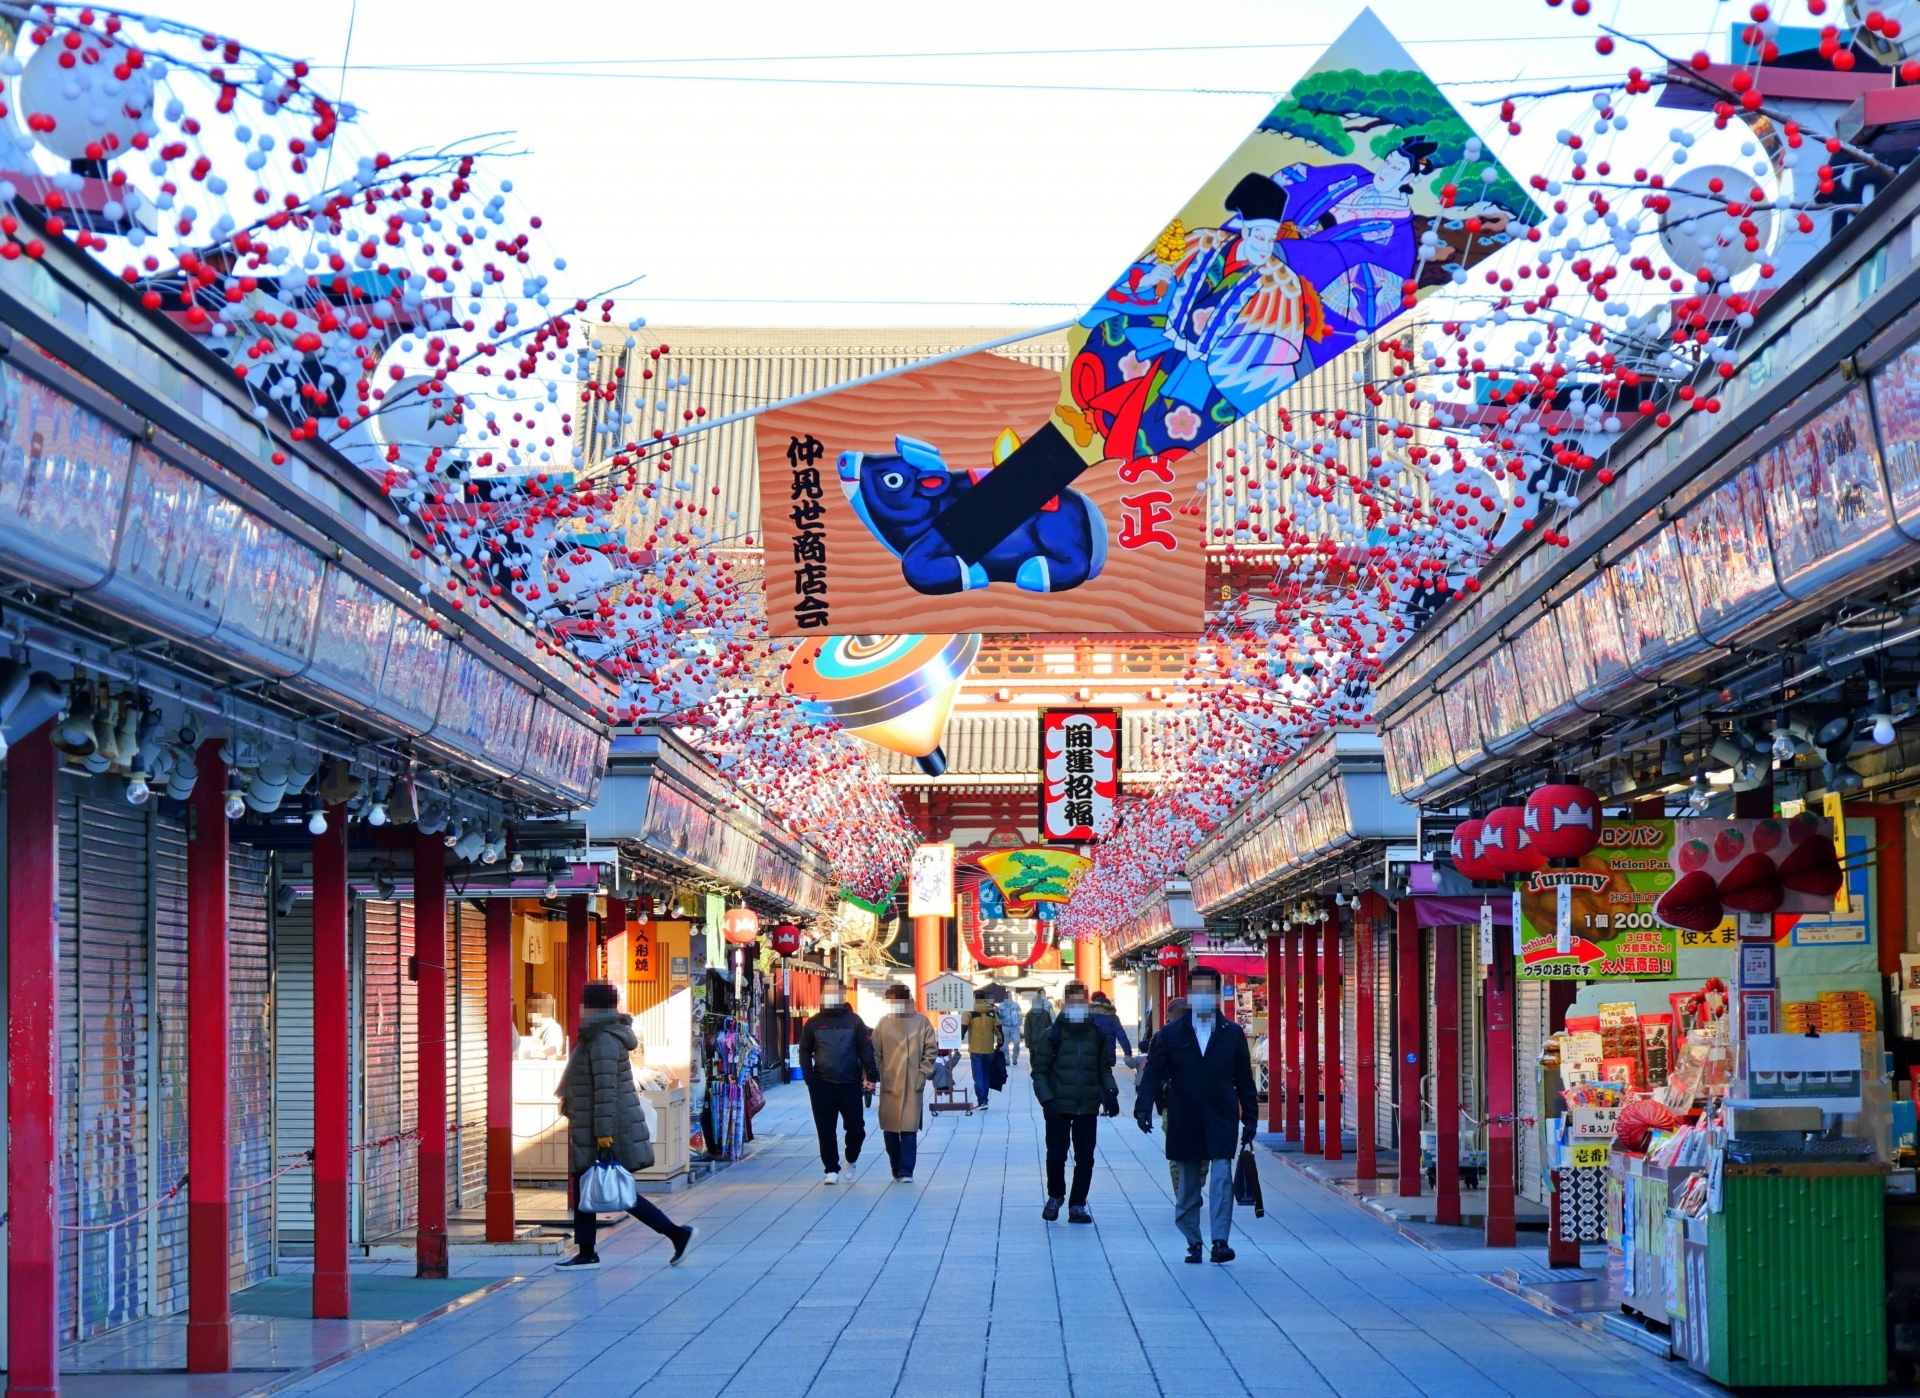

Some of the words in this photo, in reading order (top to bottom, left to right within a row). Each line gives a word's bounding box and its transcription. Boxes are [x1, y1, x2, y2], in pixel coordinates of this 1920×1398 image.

[786, 434, 829, 629] 仲見世商店会
[1064, 722, 1094, 827] 開運招福
[1611, 859, 1646, 869] Melon
[1649, 859, 1671, 869] Pan
[1528, 872, 1609, 891] Yummy
[634, 929, 649, 971] 人形焼
[1520, 935, 1553, 952] behind
[1523, 963, 1591, 977] ウラのお店です
[1575, 1148, 1608, 1163] 壱番
